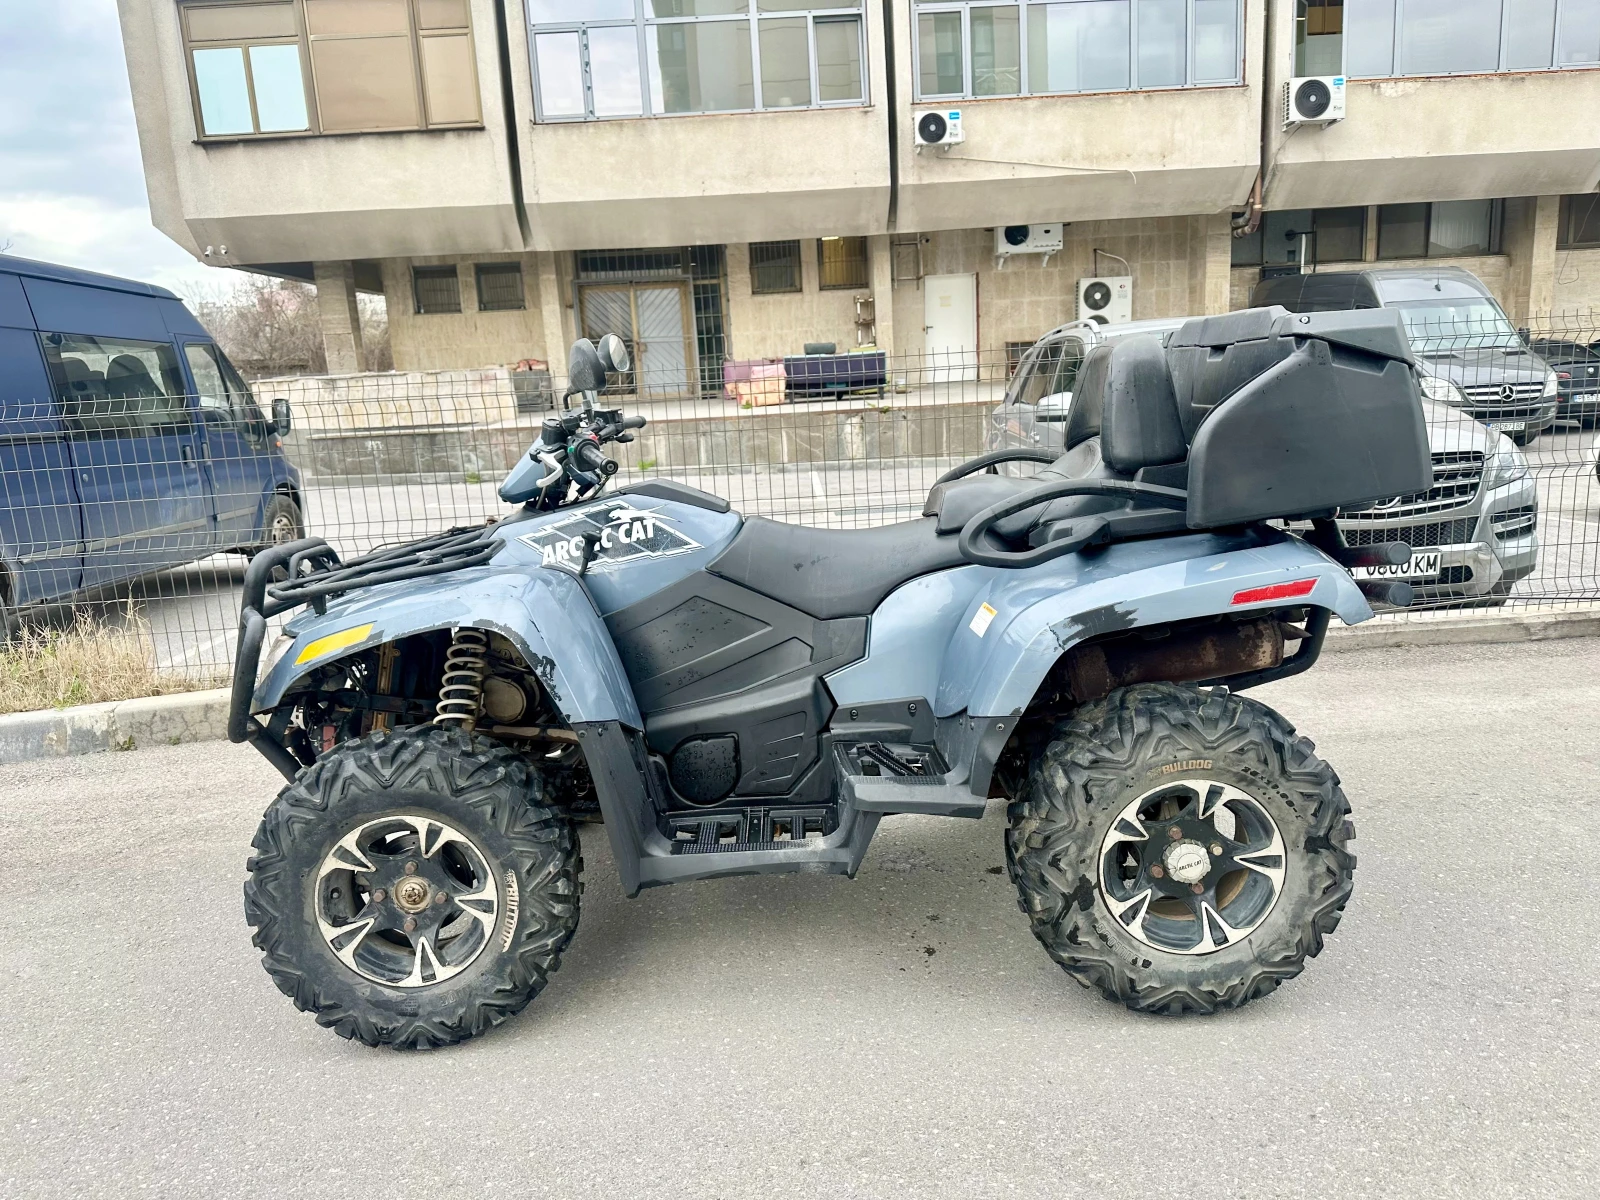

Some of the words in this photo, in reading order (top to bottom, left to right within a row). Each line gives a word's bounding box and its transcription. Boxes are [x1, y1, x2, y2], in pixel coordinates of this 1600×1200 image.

[541, 527, 613, 566] ARCC
[618, 518, 656, 544] CAT
[1413, 554, 1438, 574] KM
[1161, 759, 1213, 775] BULLDOG
[1179, 862, 1193, 871] ARCTIC
[1194, 859, 1202, 867] CAT
